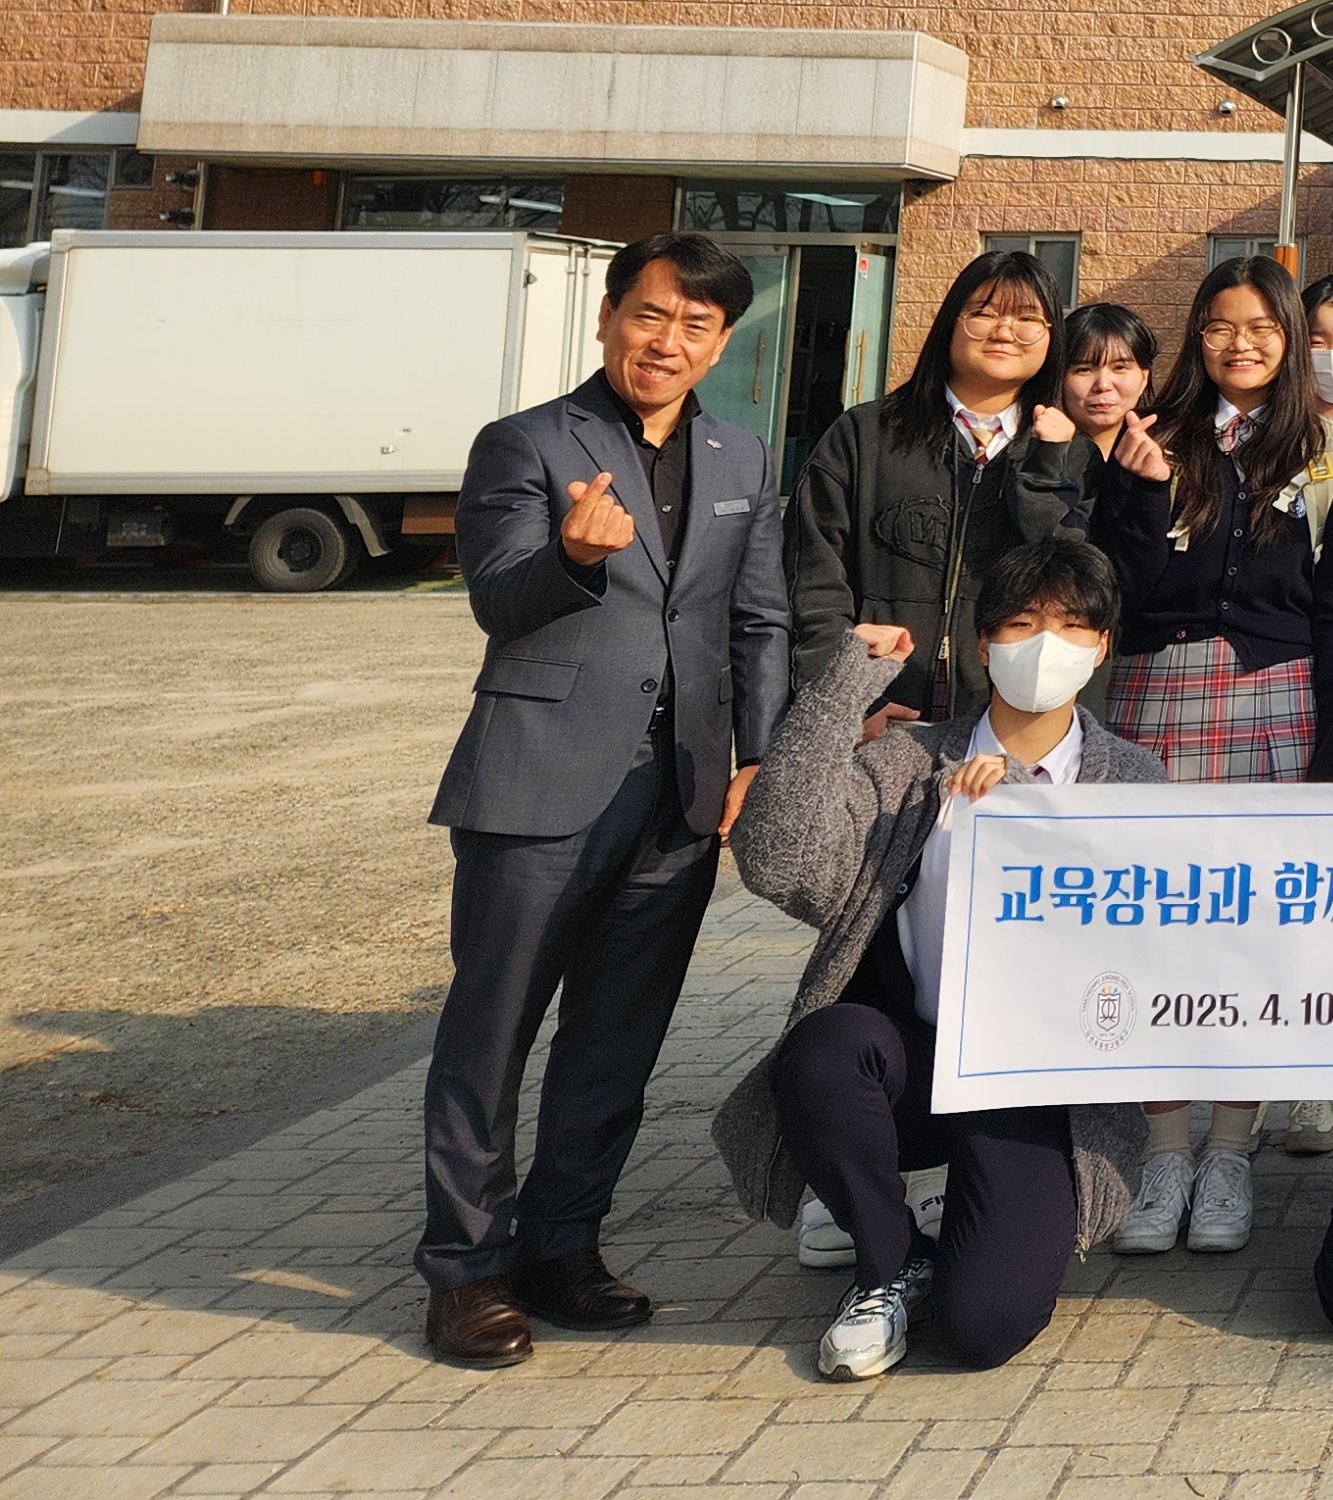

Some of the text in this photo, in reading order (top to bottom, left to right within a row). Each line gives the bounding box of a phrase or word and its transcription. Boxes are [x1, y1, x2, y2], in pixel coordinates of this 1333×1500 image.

[996, 863, 1258, 928] 교육장님과
[1150, 993, 1248, 1028] 2025.
[1259, 993, 1290, 1027] 4.
[919, 1194, 945, 1212] FI
